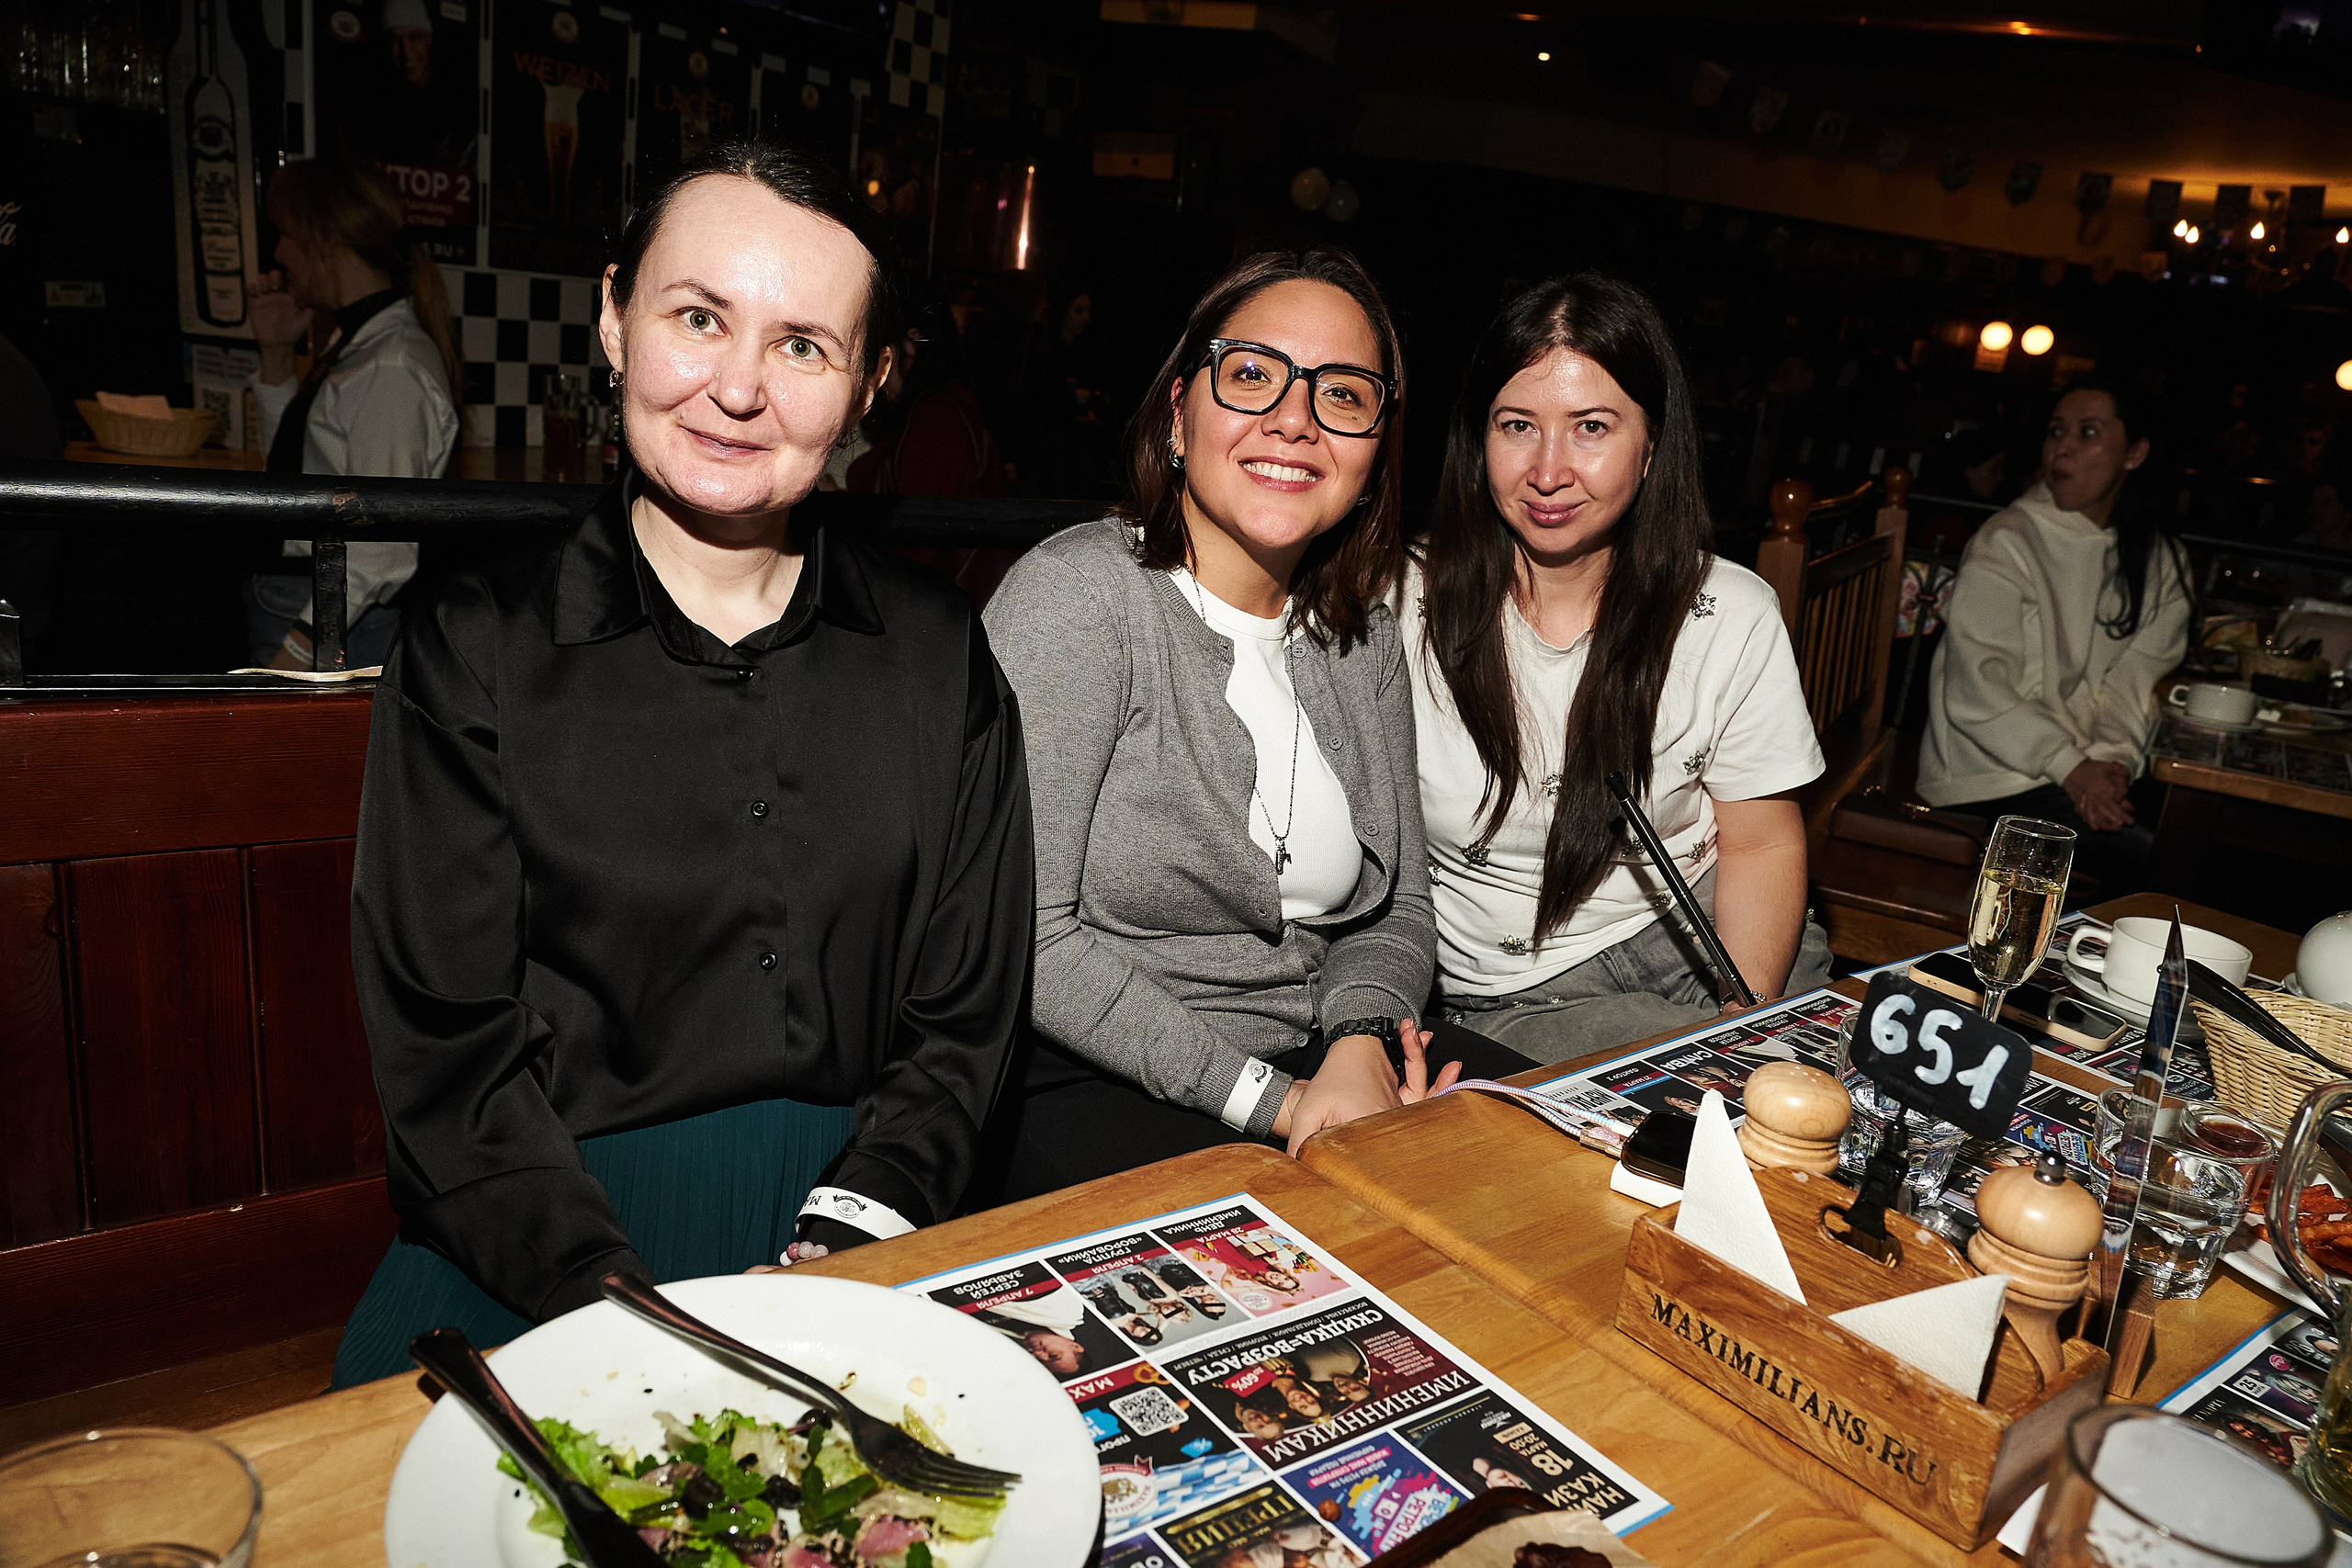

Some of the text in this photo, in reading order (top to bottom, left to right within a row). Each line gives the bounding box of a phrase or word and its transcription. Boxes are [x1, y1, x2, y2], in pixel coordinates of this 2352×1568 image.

[456, 175, 471, 202] 2
[1871, 994, 2009, 1110] 651
[1162, 1209, 1241, 1235] ИМЕНИННИКА
[1193, 1220, 1226, 1234] ДЕНЬ
[1195, 1226, 1245, 1244] 28 МАРТА
[1057, 1236, 1142, 1264] «ВОРОВАЙКИ»
[1082, 1246, 1132, 1265] ГРУППА
[1091, 1256, 1134, 1274] АПРЕЛЯ
[953, 1270, 1024, 1294] ЗАВЬЯЛОВ
[969, 1280, 1020, 1299] СЕРГЕЙ
[976, 1287, 1034, 1309] 7 АПРЕЛЯ
[1187, 1309, 1384, 1386] СКИДКА=ВОЗРАСТУ
[1207, 1347, 1231, 1359] СРЕДА
[1231, 1373, 1260, 1392] 60%
[1650, 1292, 1936, 1486] MAXIMILIANS.RU
[2239, 1379, 2256, 1391] 25
[1261, 1370, 1471, 1462] ИМЕНИННИКАМ
[1509, 1432, 1539, 1450] 20:00
[1518, 1439, 1548, 1457] МАРТА
[1531, 1449, 1574, 1476] 18
[1176, 1495, 1295, 1555] ГРЕЦИЯ
[1396, 1496, 1427, 1535] РЕТРО
